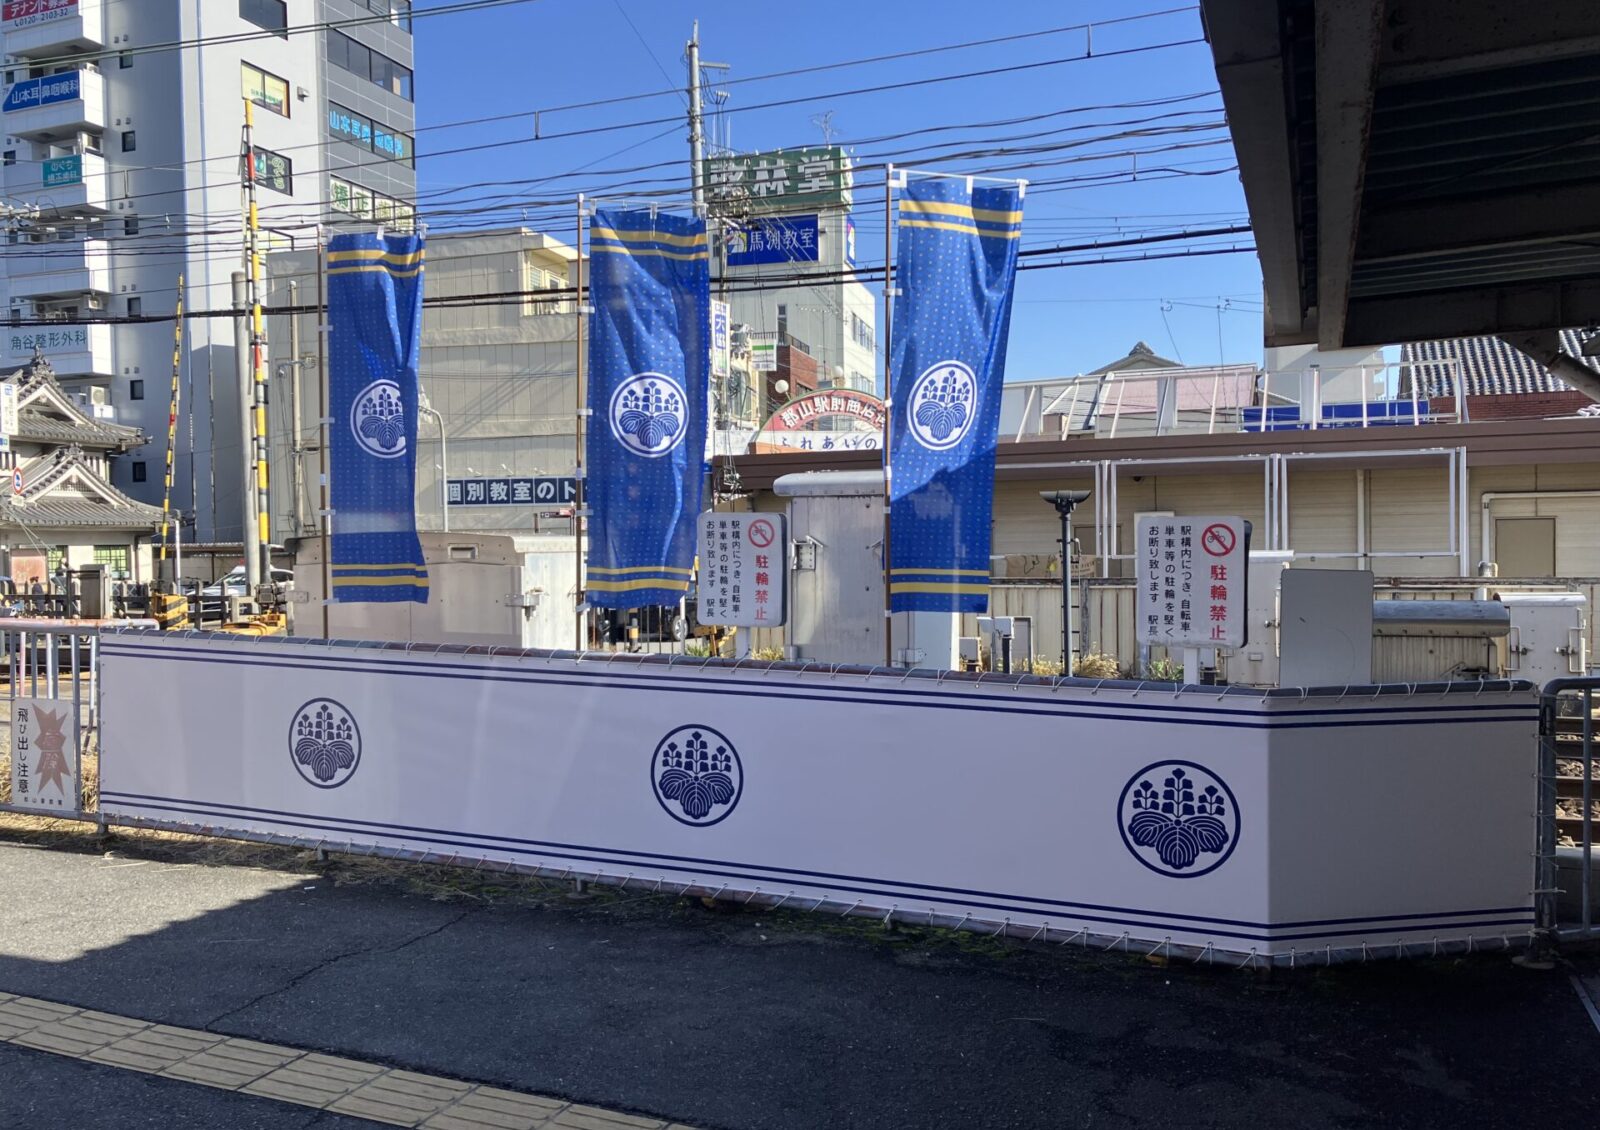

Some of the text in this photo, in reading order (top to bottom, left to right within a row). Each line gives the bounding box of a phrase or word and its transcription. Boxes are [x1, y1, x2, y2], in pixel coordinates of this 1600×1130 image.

[11, 329, 87, 351] 角谷整形外科
[706, 521, 716, 618] お断り致します 駅長
[719, 520, 729, 619] 単車等の駐輪を堅く
[755, 555, 769, 621] 駐輪禁止
[1147, 526, 1159, 637] お断り致します 駅長
[1164, 525, 1175, 638] 単車等の駐輪を堅く
[1209, 564, 1227, 641] 駐輪禁止
[17, 707, 29, 793] 飛び出し注意
